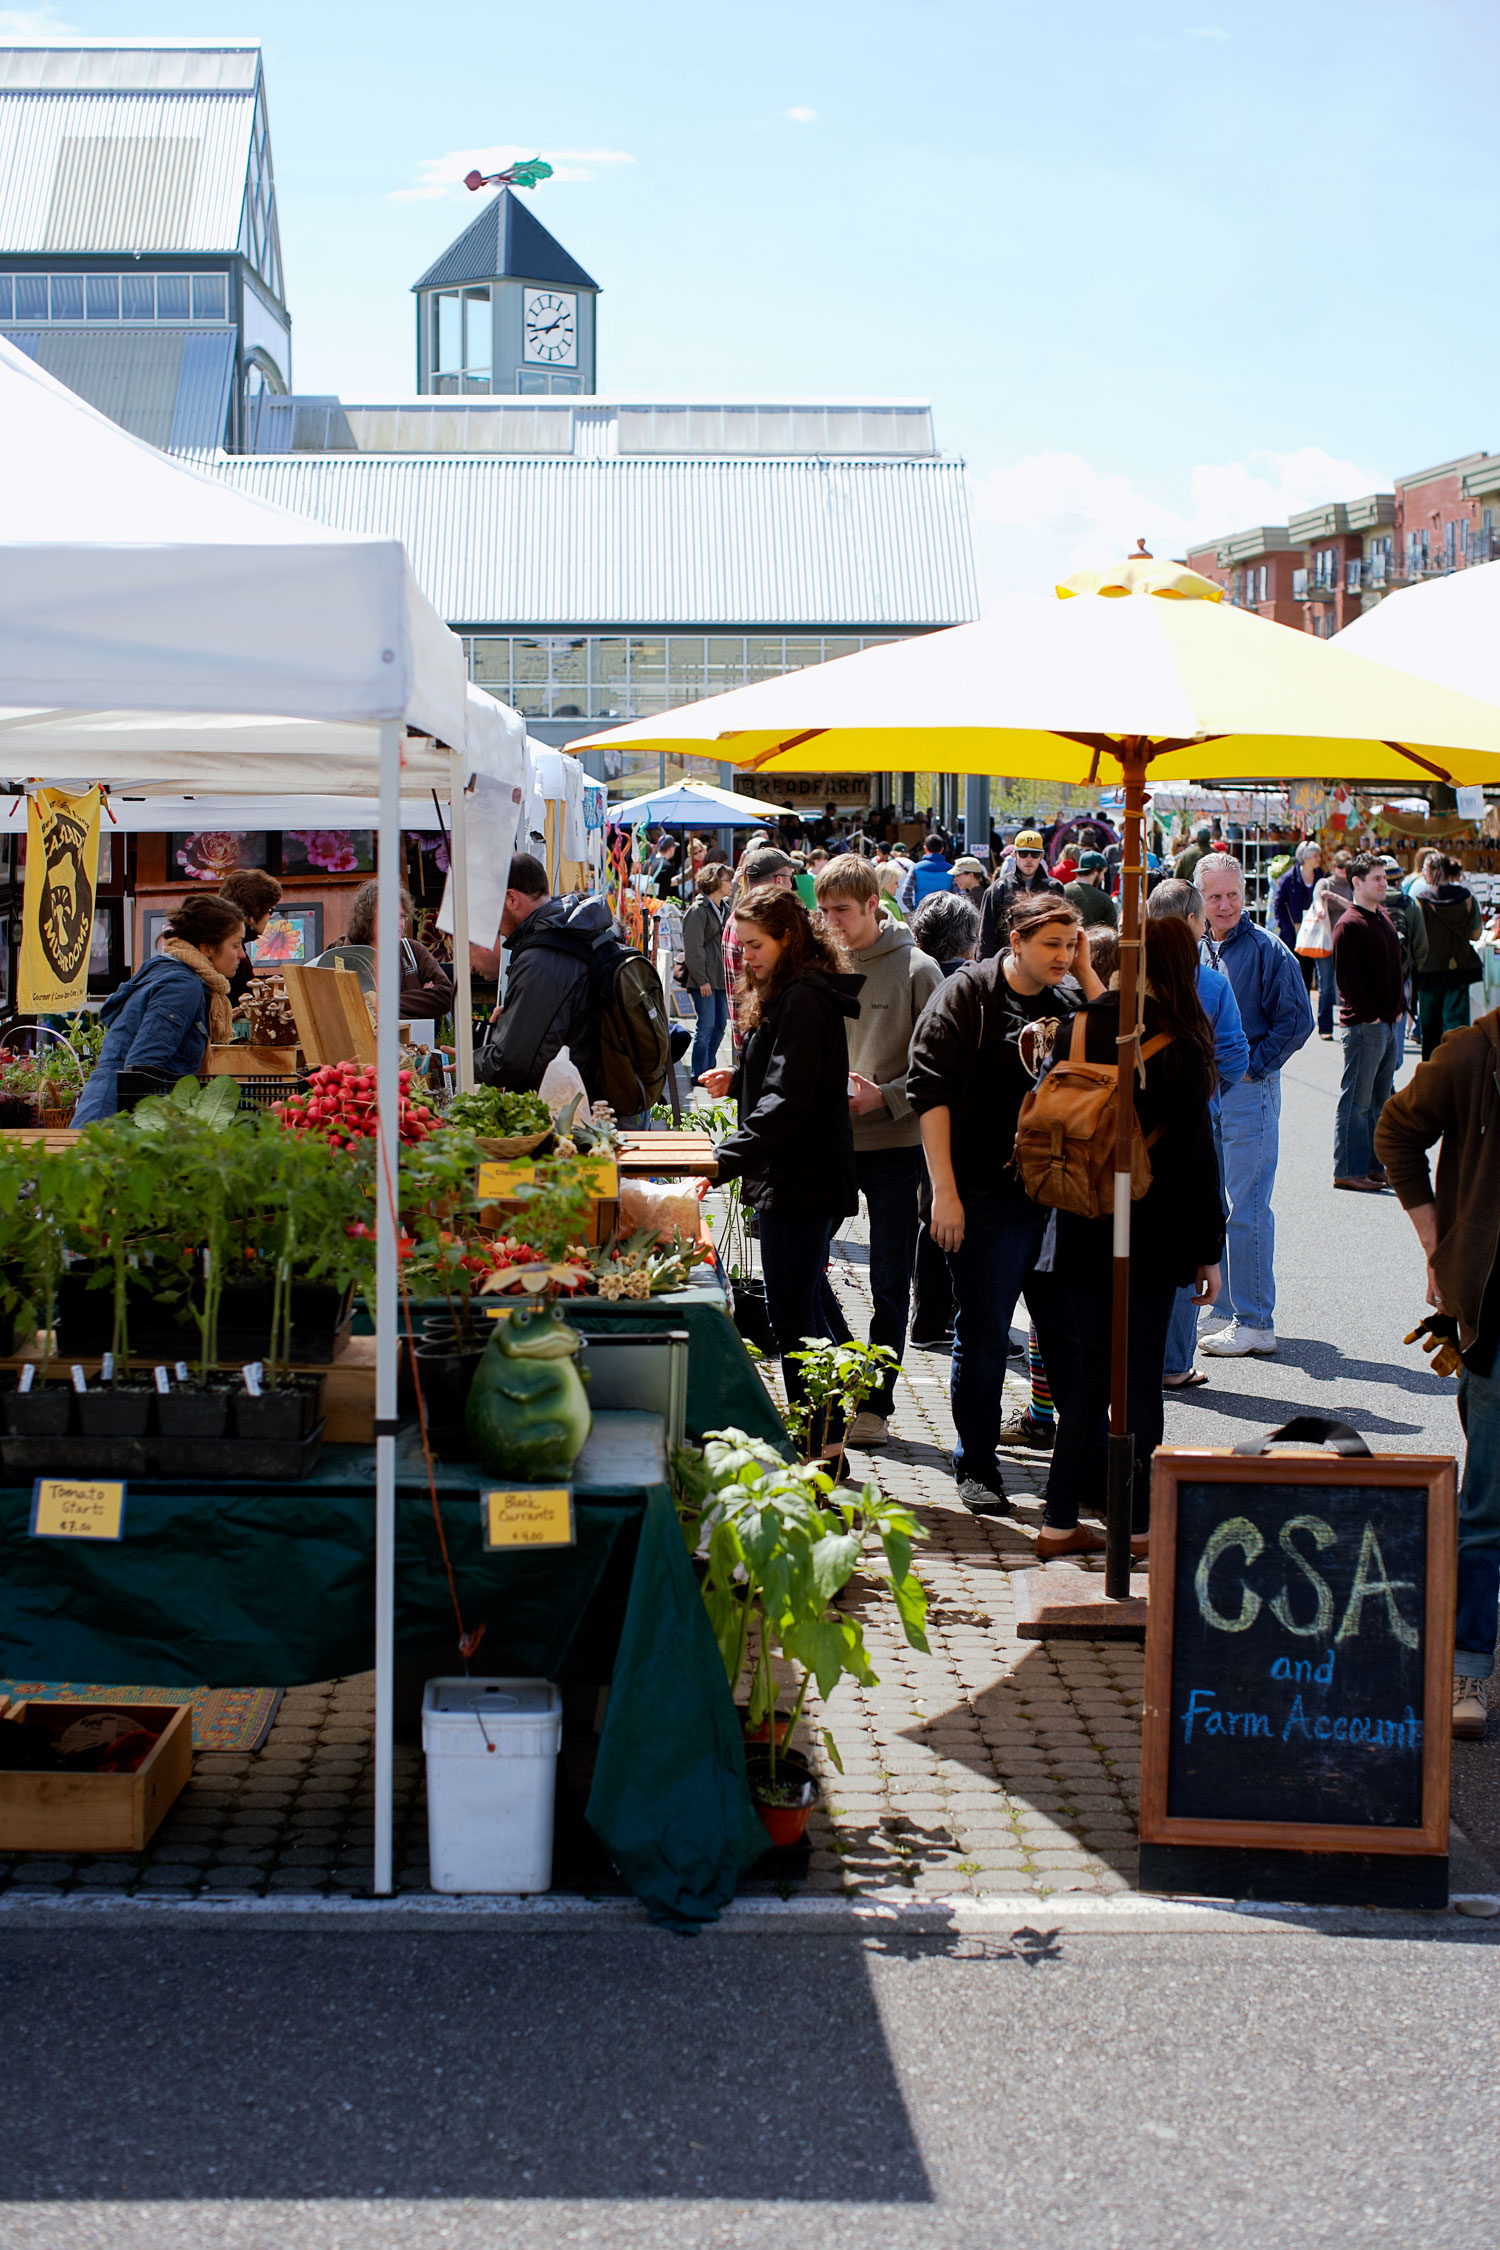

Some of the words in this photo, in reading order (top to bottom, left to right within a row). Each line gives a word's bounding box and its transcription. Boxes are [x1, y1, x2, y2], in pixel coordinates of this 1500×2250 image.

[1026, 836, 1033, 844] P
[43, 911, 89, 973] MUSHROOMS
[49, 1484, 105, 1500] Tomato
[62, 1501, 105, 1516] Starts
[505, 1494, 541, 1509] Black
[498, 1508, 555, 1522] Currants
[1194, 1513, 1420, 1650] CSA
[1269, 1649, 1336, 1686] and
[1180, 1689, 1272, 1745] Farm
[1281, 1693, 1424, 1750] Account
